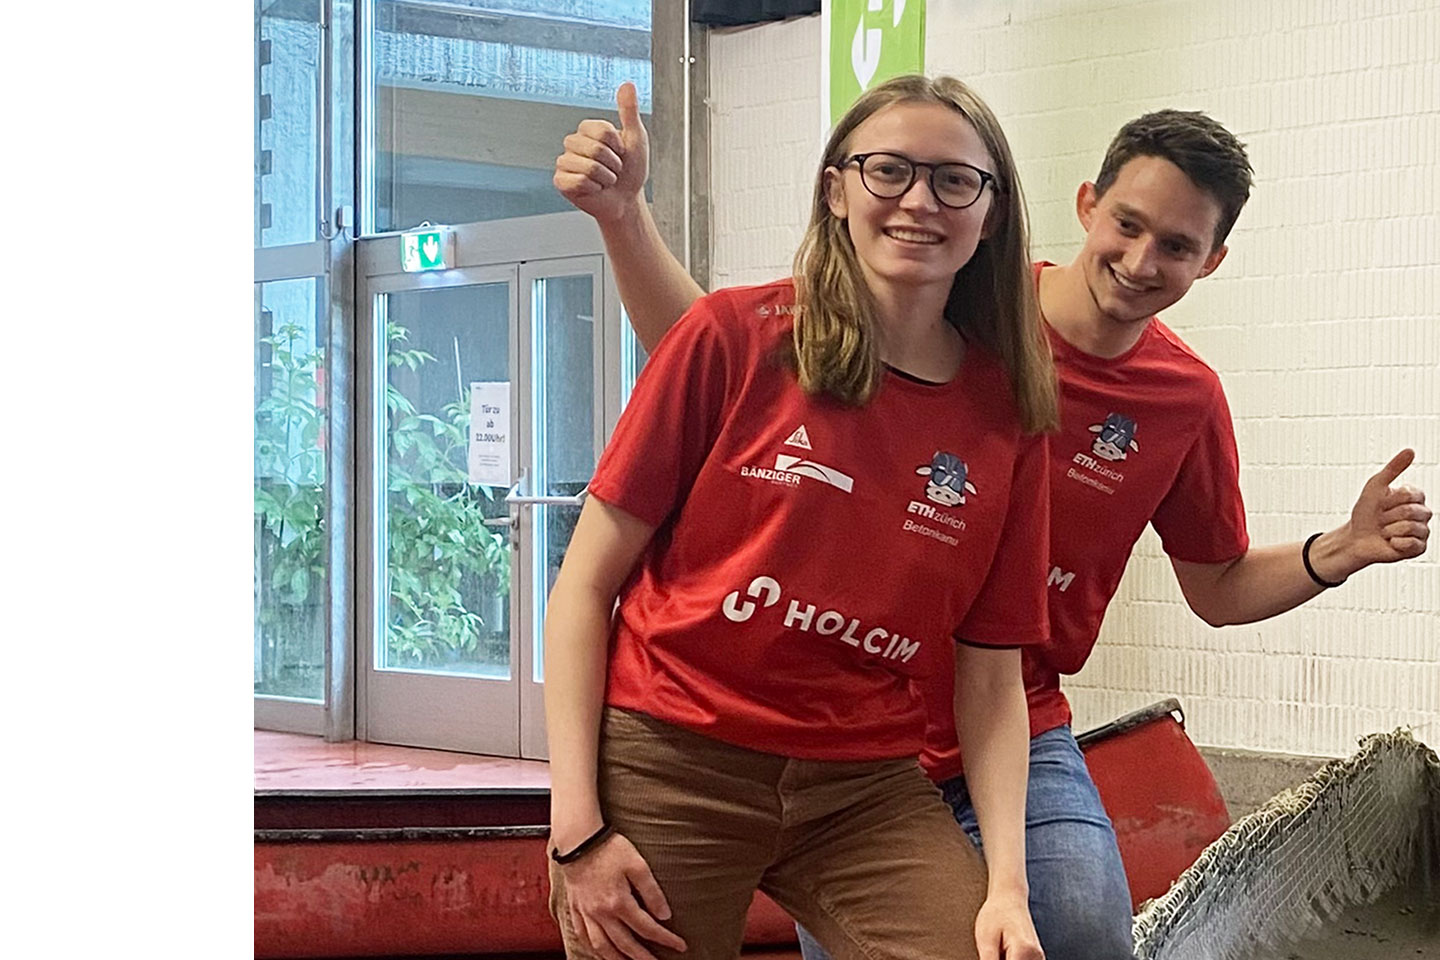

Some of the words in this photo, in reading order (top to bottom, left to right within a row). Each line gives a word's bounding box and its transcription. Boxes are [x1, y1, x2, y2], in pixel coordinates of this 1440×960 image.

[740, 464, 801, 485] BÄNZIGER
[902, 519, 959, 547] Betonkanu
[783, 599, 921, 663] HOLCIM
